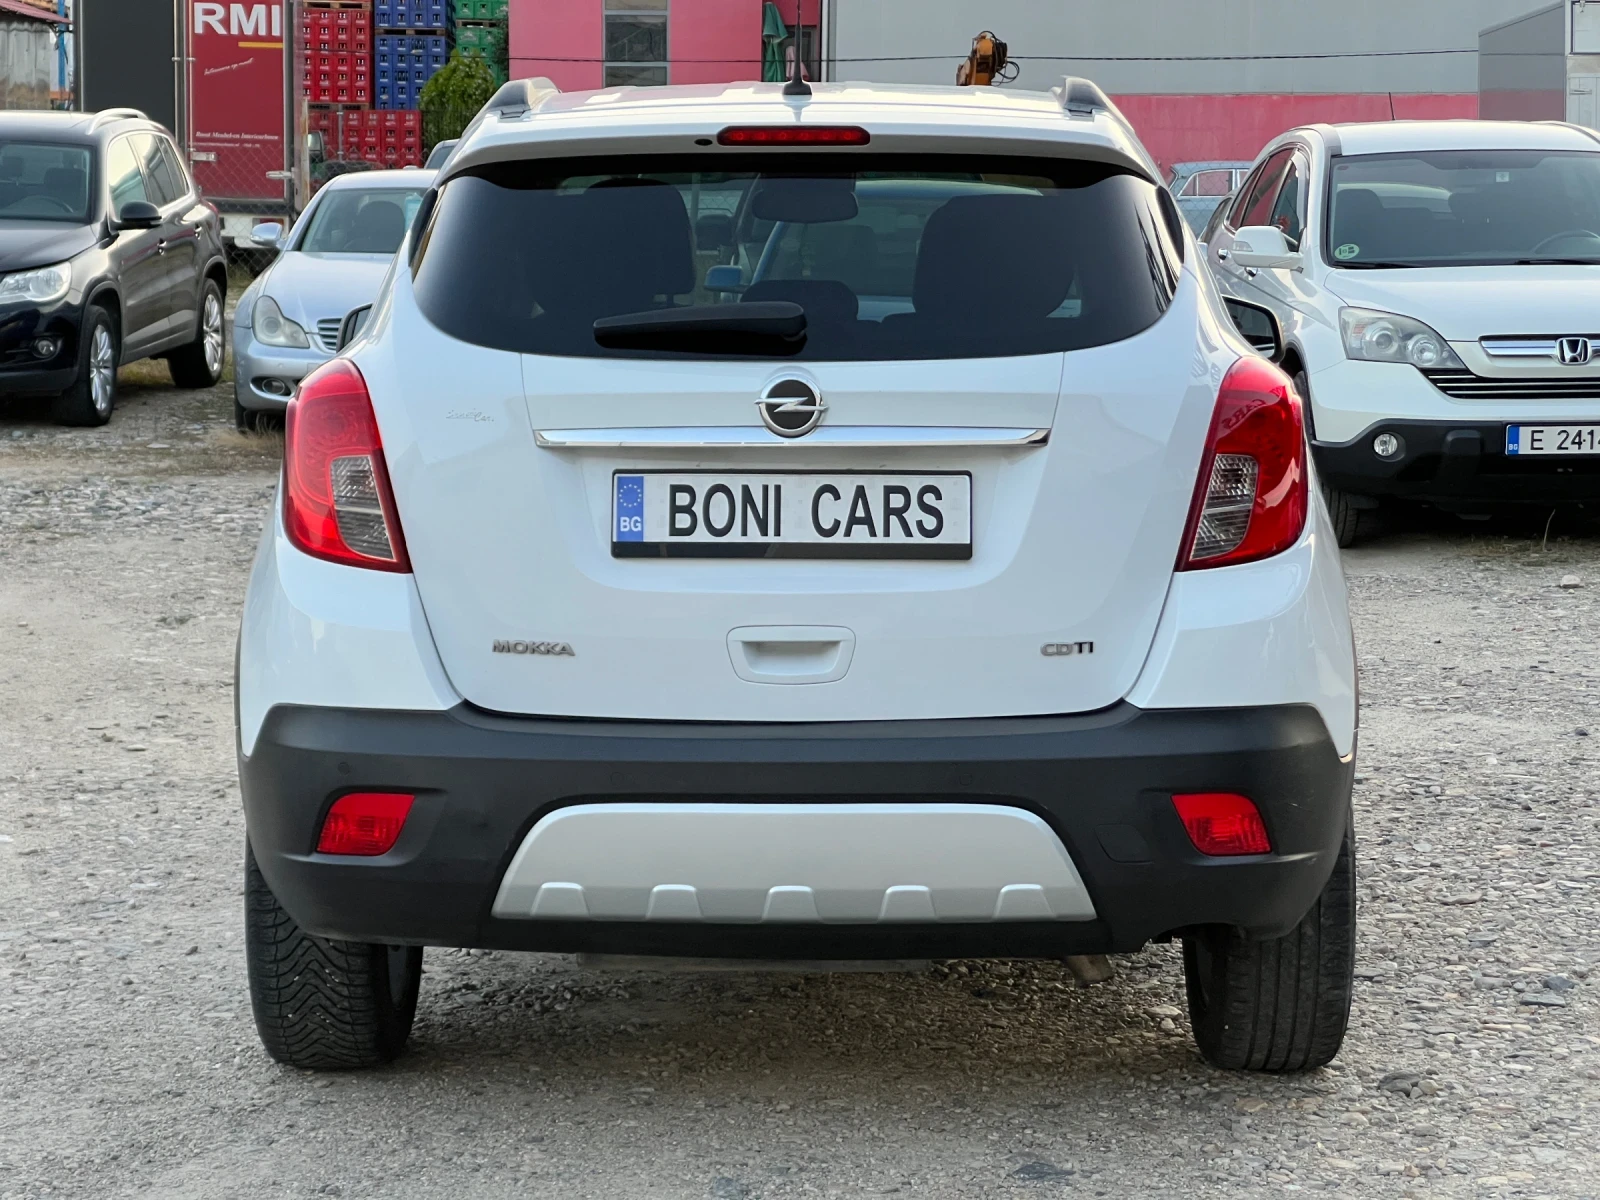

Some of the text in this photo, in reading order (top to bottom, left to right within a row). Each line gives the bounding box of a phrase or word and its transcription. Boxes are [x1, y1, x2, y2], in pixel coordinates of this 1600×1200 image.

[193, 2, 281, 37] RMI
[1508, 443, 1518, 451] BG
[1530, 429, 1600, 450] E 241
[668, 483, 944, 539] BONI CARS
[619, 516, 642, 532] BG
[492, 639, 576, 657] MOKKA
[1041, 641, 1094, 657] CDTI
